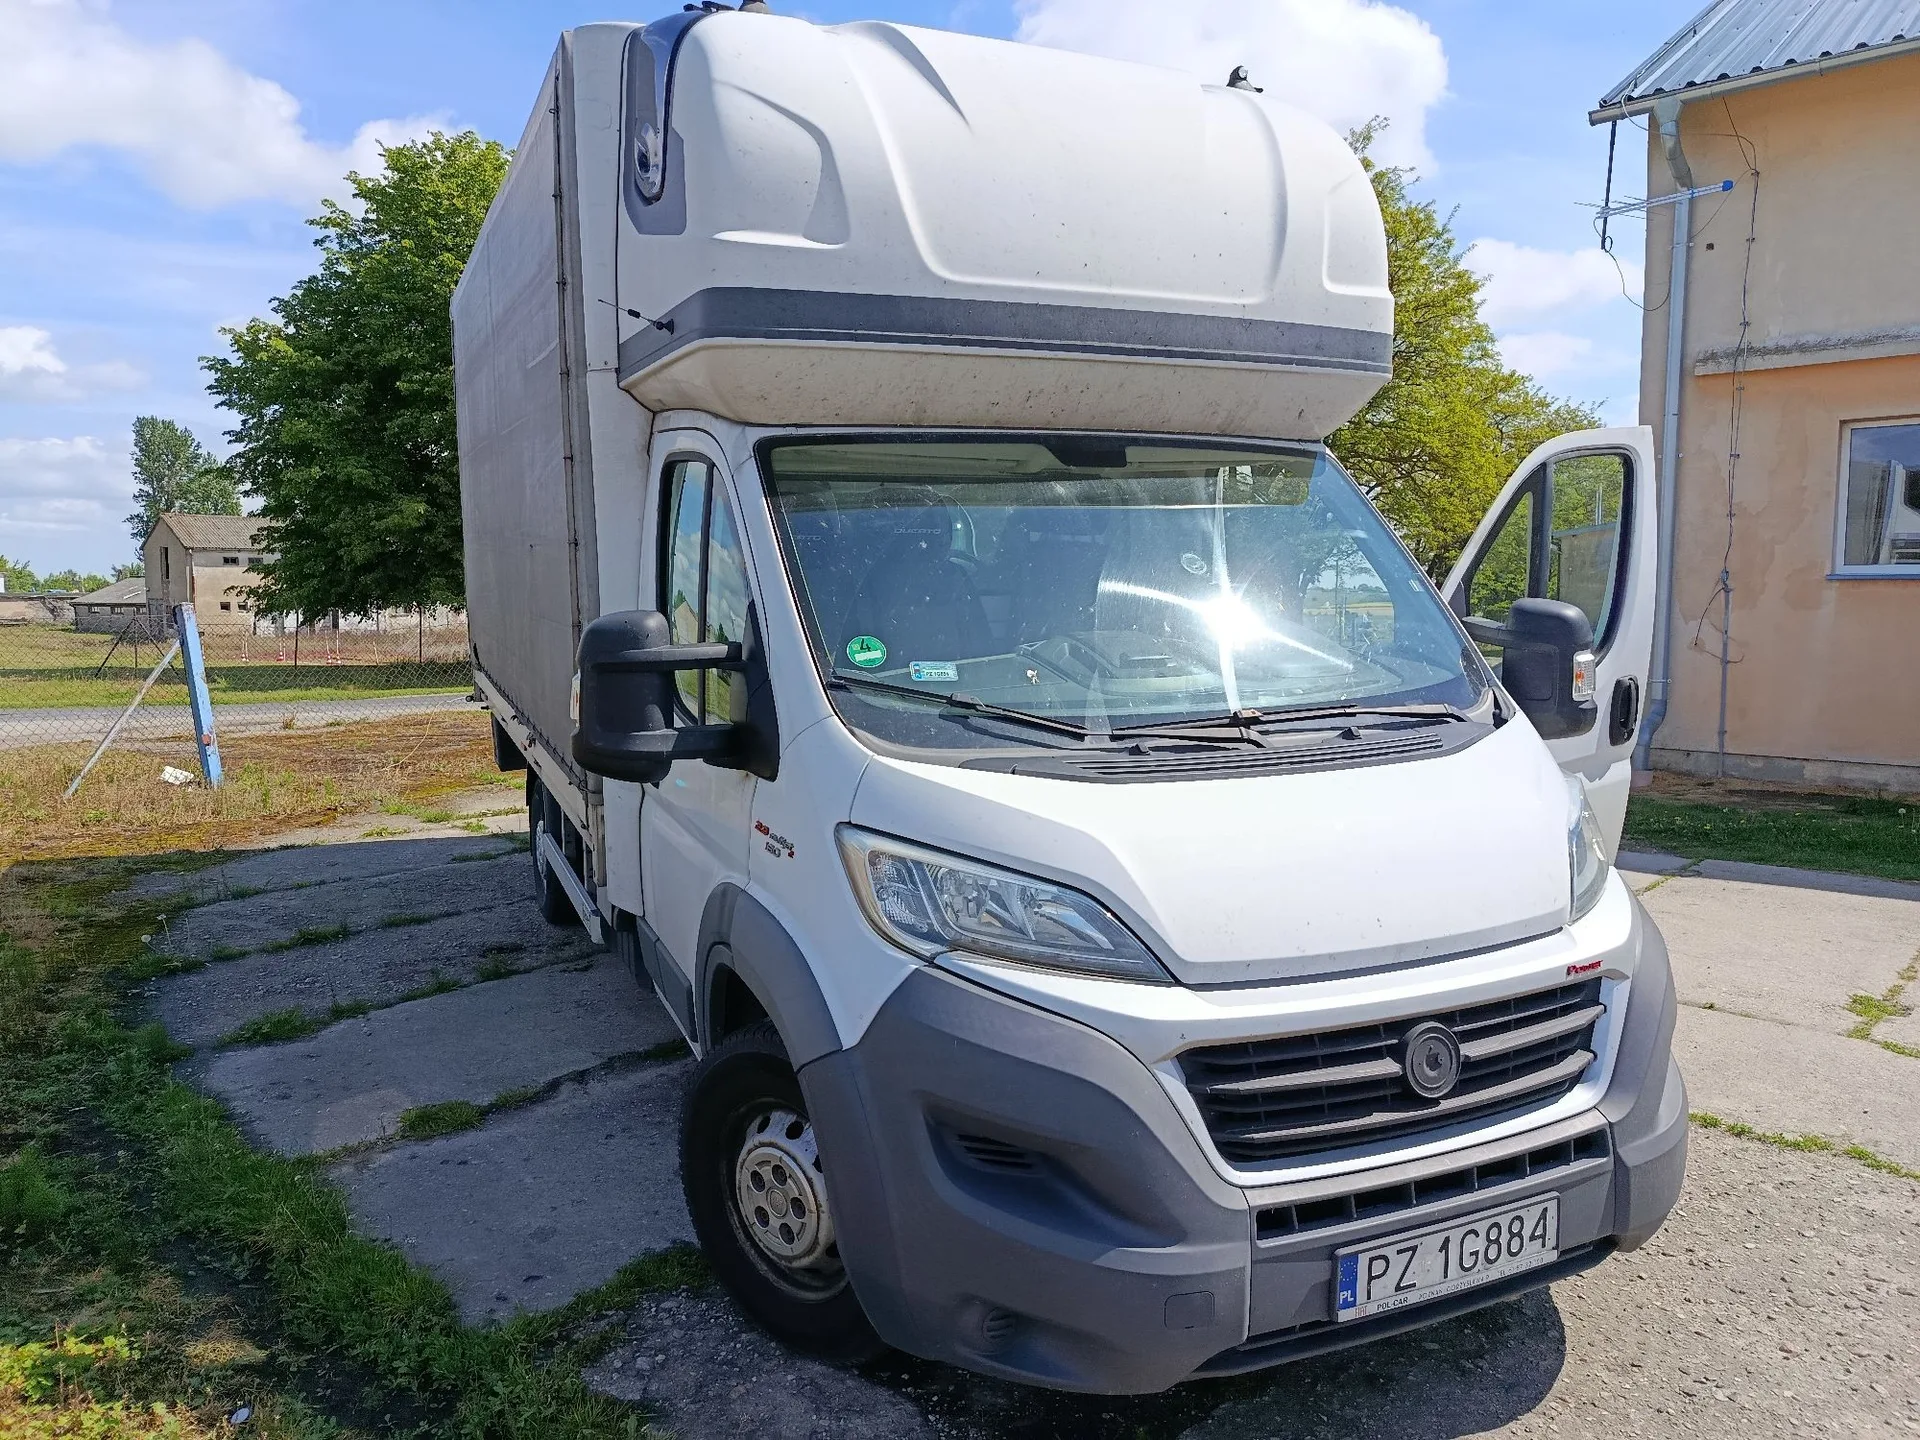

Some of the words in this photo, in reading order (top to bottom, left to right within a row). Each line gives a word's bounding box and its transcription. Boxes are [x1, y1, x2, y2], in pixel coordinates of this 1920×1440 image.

[860, 638, 871, 651] 4
[1566, 960, 1603, 976] Power
[1366, 1244, 1418, 1301] PZ
[1438, 1206, 1549, 1279] 1G884
[1339, 1289, 1355, 1305] PL
